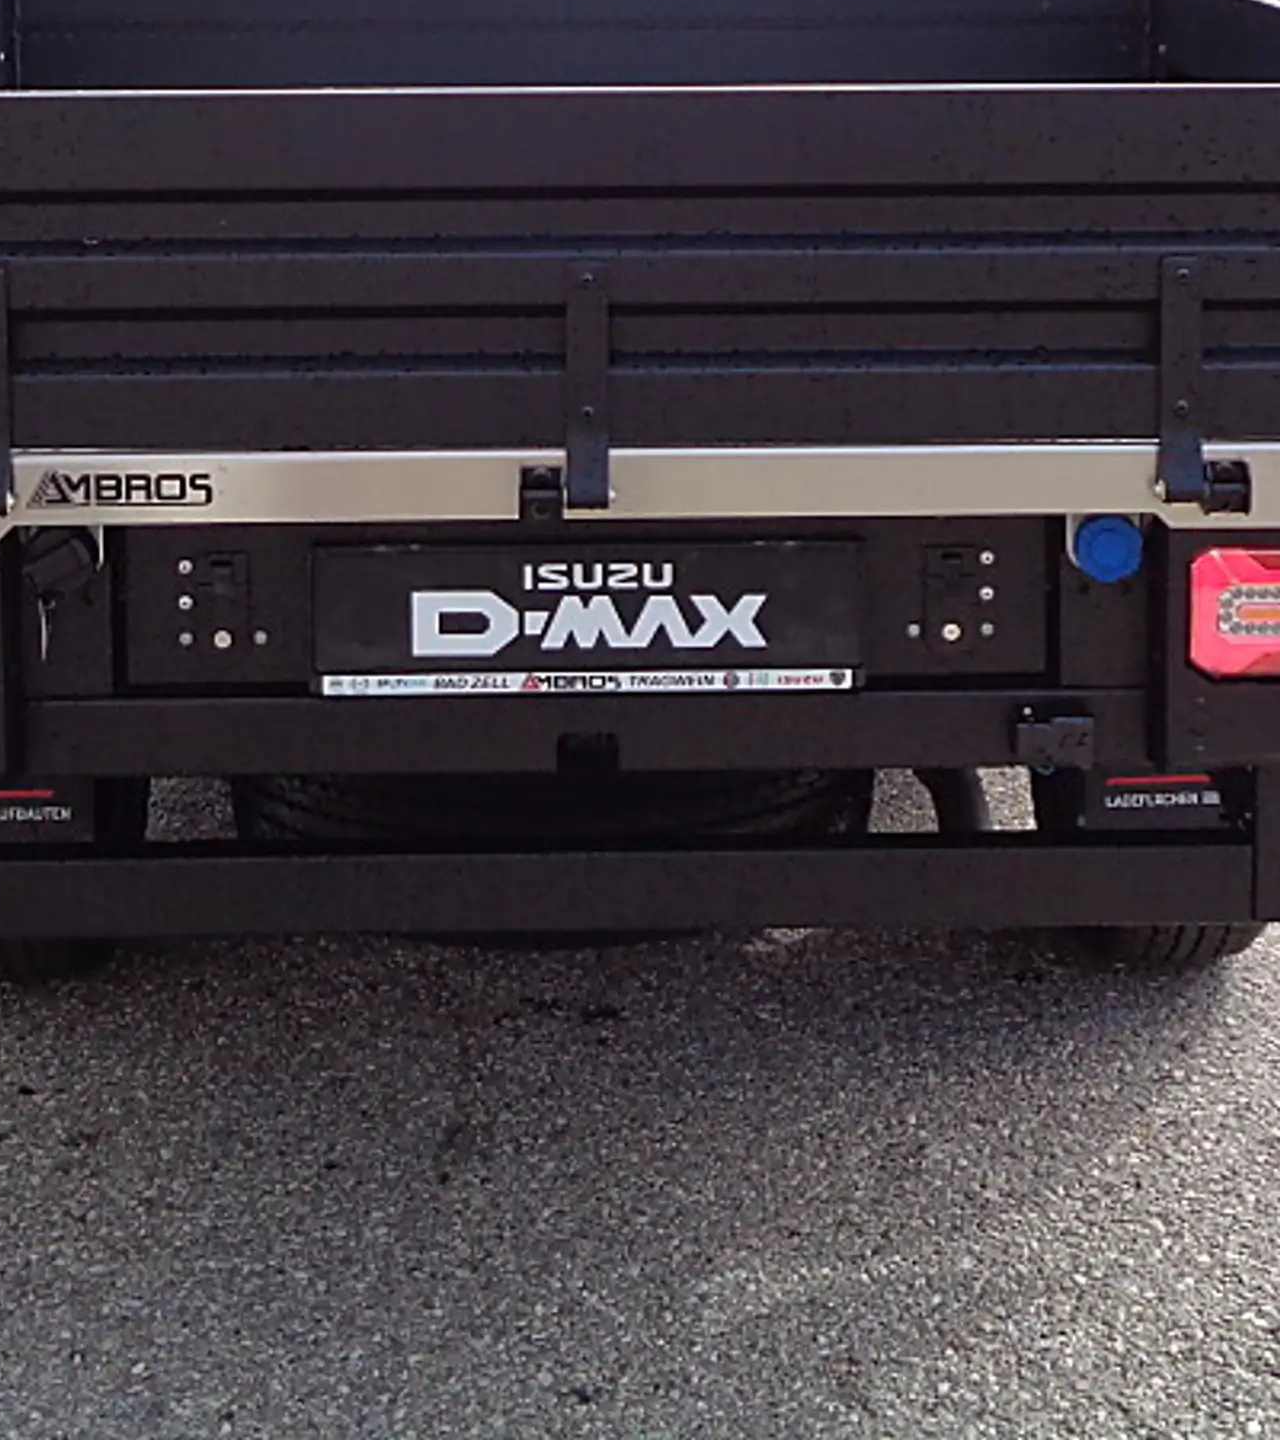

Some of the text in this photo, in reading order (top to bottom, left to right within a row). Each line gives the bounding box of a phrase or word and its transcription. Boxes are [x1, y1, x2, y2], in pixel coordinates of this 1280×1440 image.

[26, 470, 213, 508] AMBROS
[524, 563, 674, 590] ISUZU
[412, 590, 768, 657] D-MAX
